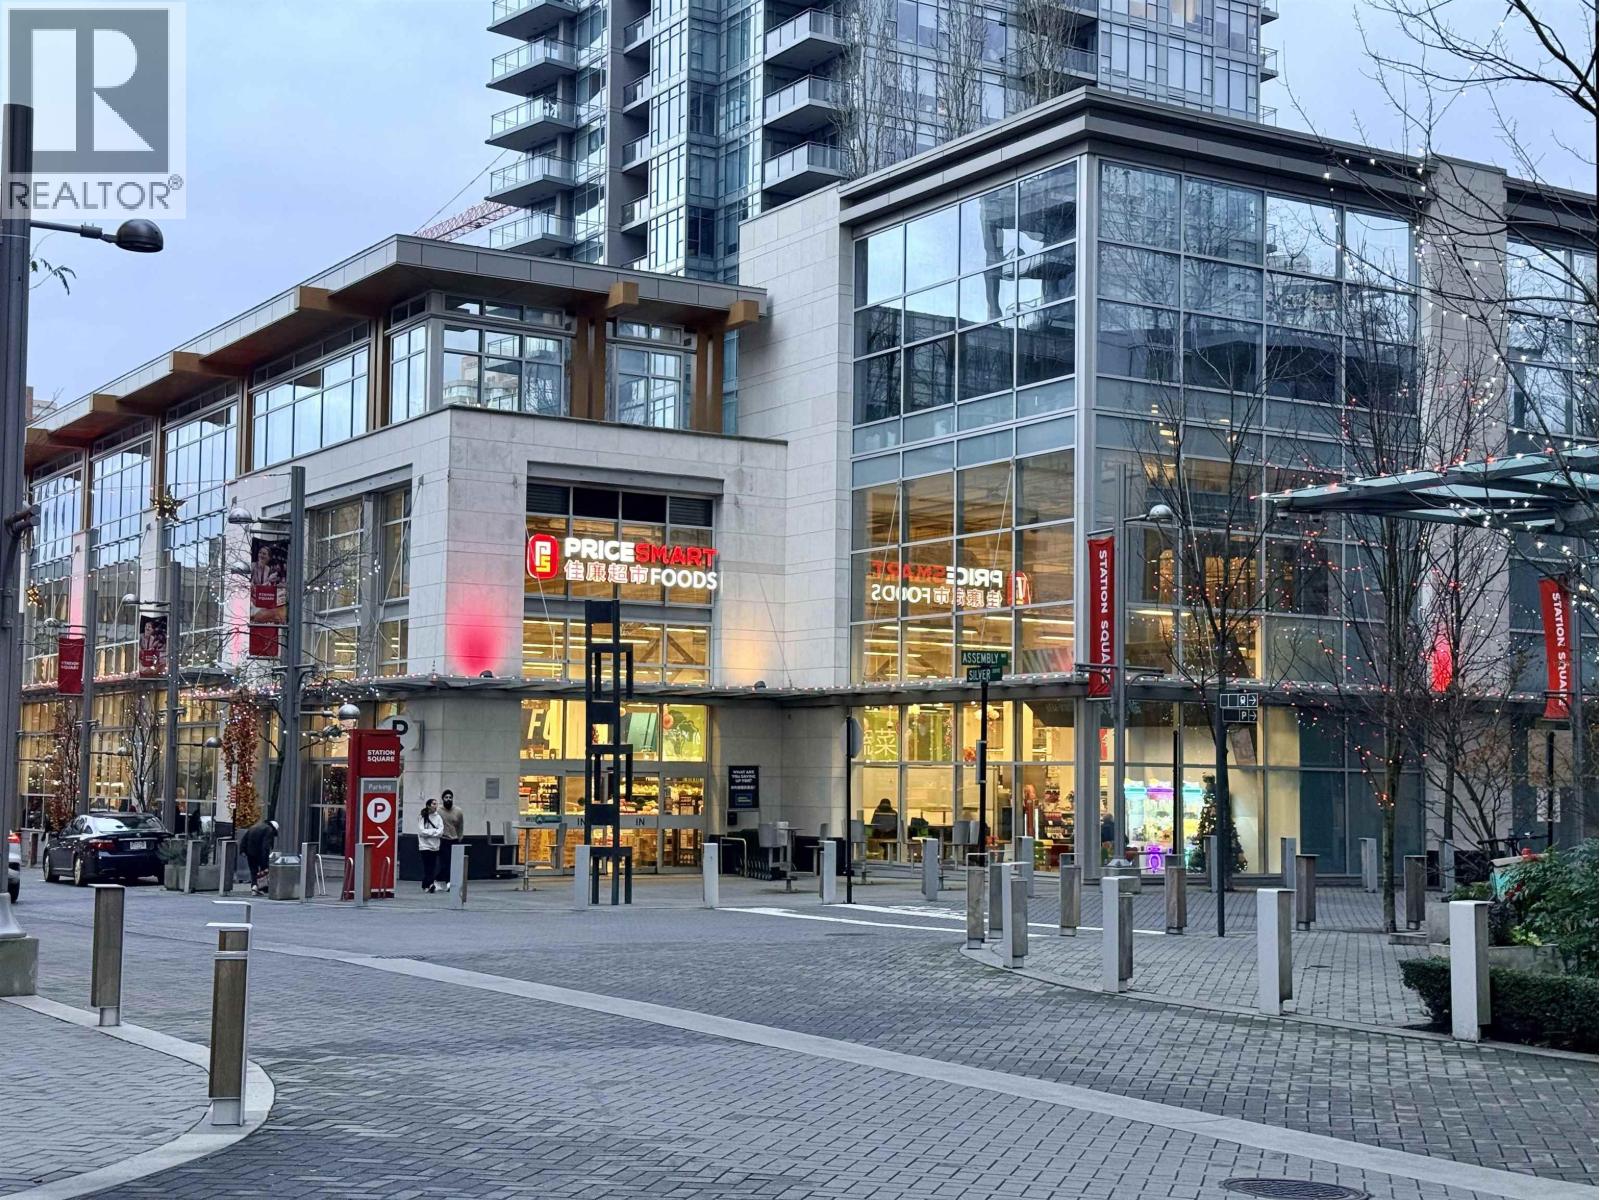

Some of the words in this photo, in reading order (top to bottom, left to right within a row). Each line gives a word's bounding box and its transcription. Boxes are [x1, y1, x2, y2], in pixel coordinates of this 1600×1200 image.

[564, 537, 718, 567] PRICESMART
[563, 559, 649, 584] 佳廉超市
[650, 567, 718, 590] FOODS
[1099, 549, 1109, 614] STATION
[1552, 592, 1566, 647] STATION
[962, 652, 999, 664] ASSEMBLY
[968, 669, 991, 681] SILVER
[368, 783, 392, 793] Parking
[373, 802, 386, 819] P
[636, 818, 645, 826] IN
